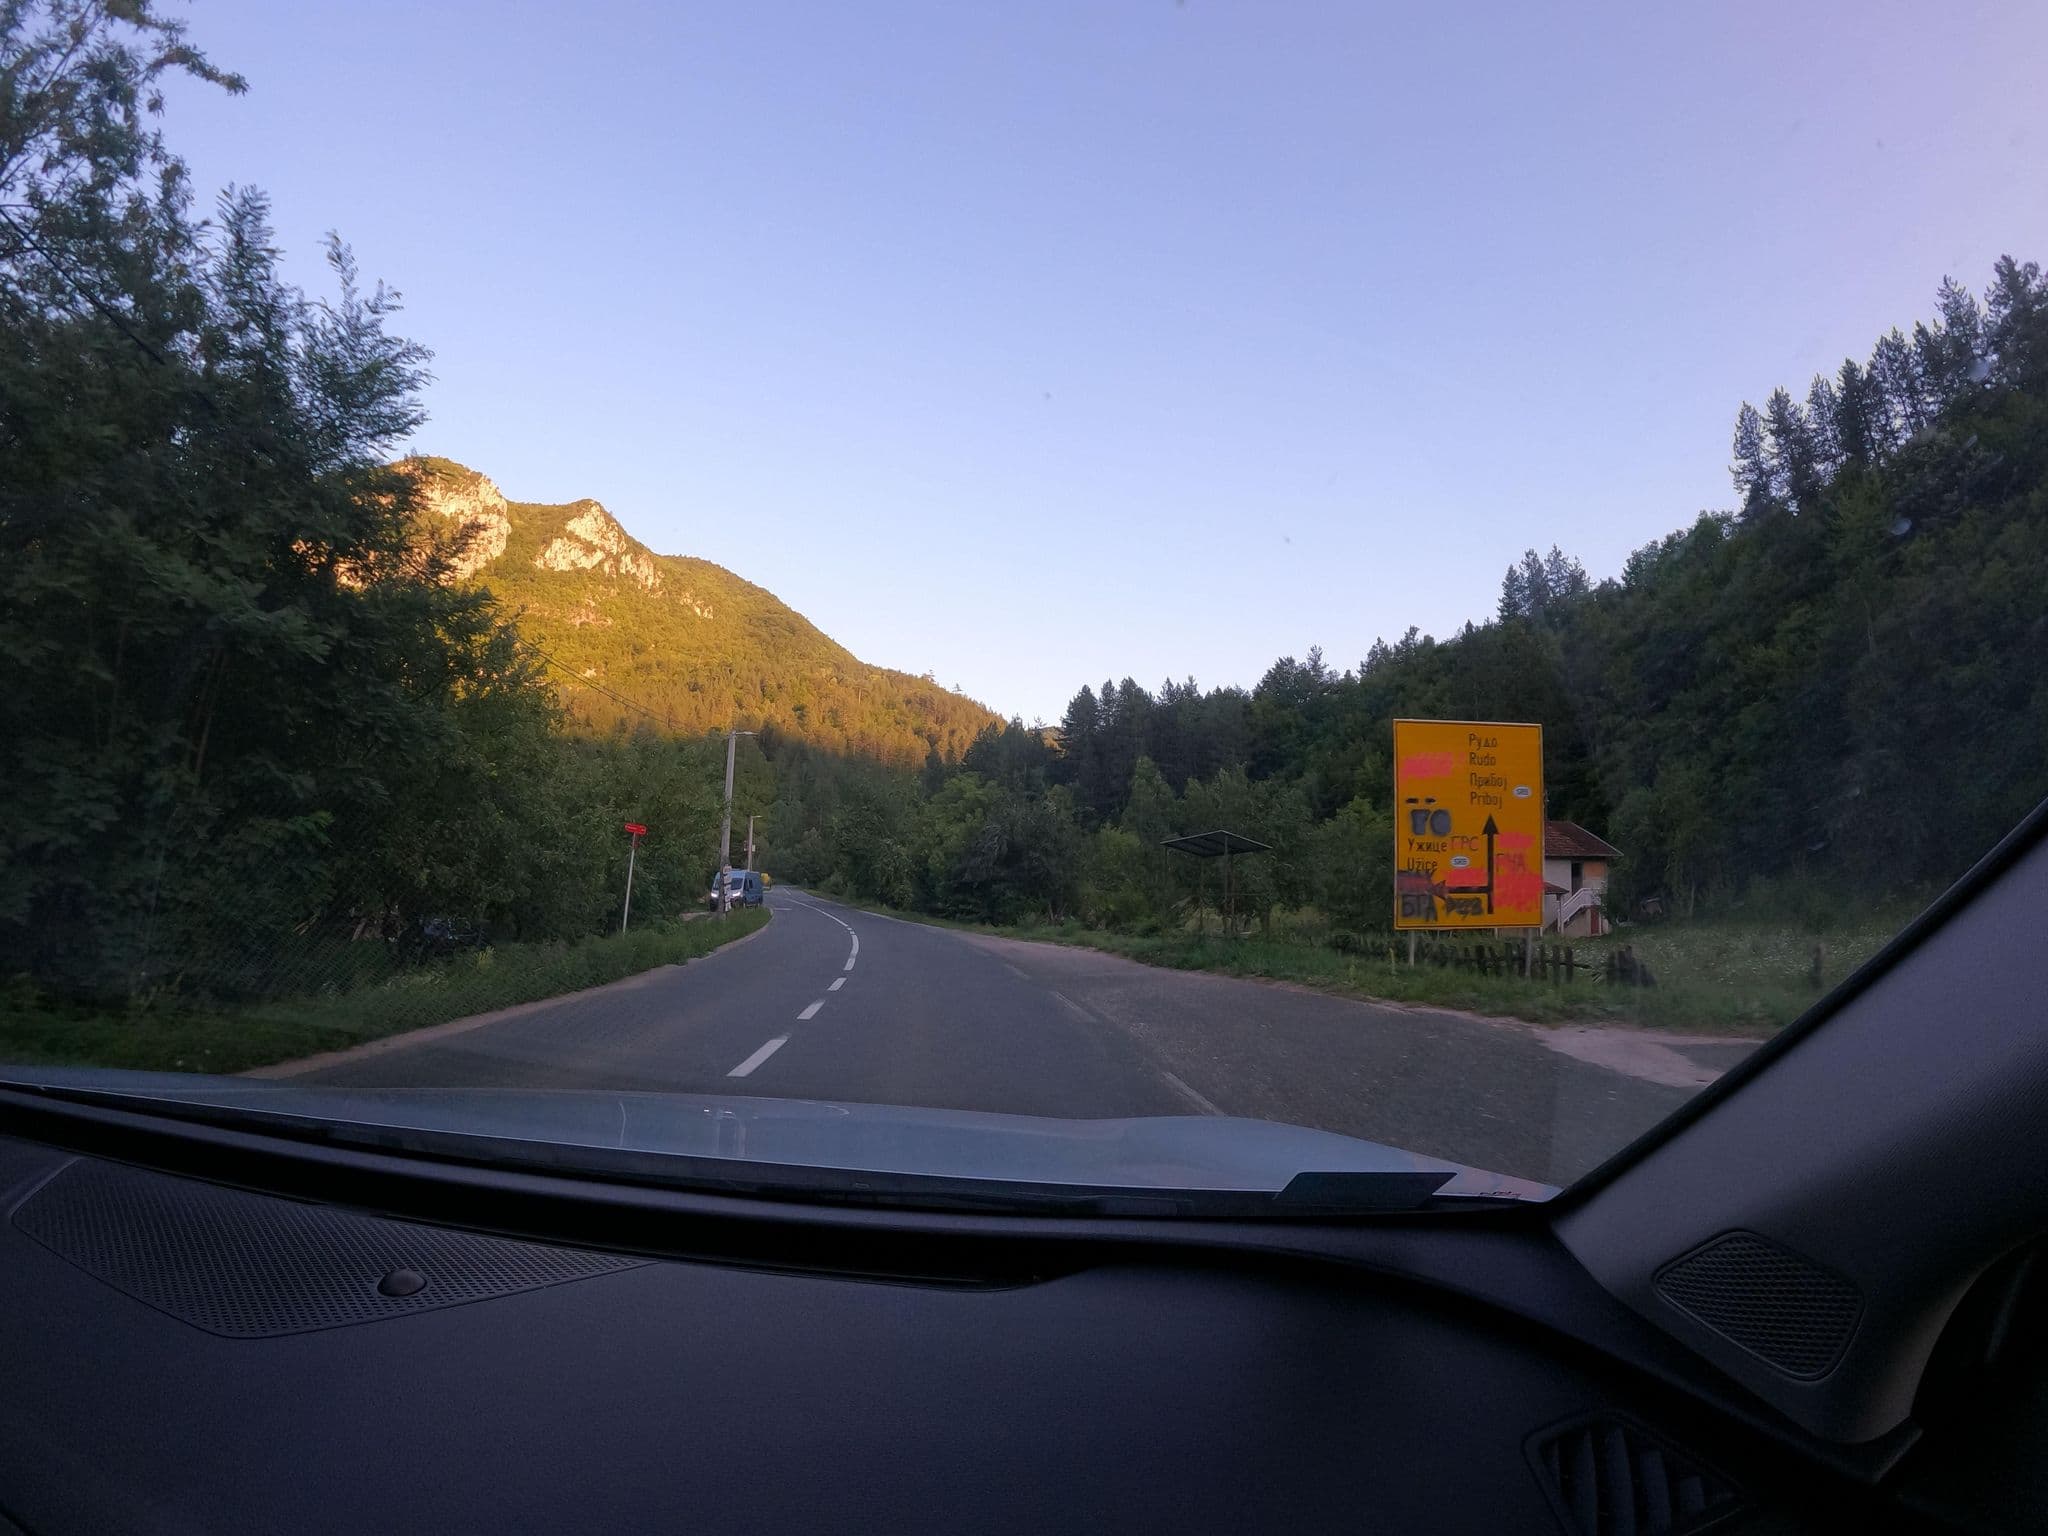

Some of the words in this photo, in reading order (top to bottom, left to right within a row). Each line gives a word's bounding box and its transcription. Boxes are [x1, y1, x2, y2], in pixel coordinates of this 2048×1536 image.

[1469, 733, 1498, 750] Рудо
[1469, 752, 1497, 766] Rudo
[1470, 772, 1507, 791] Прибој
[1470, 792, 1503, 810] Priboj
[1407, 837, 1449, 853] Ужице
[1407, 856, 1438, 872] Užice
